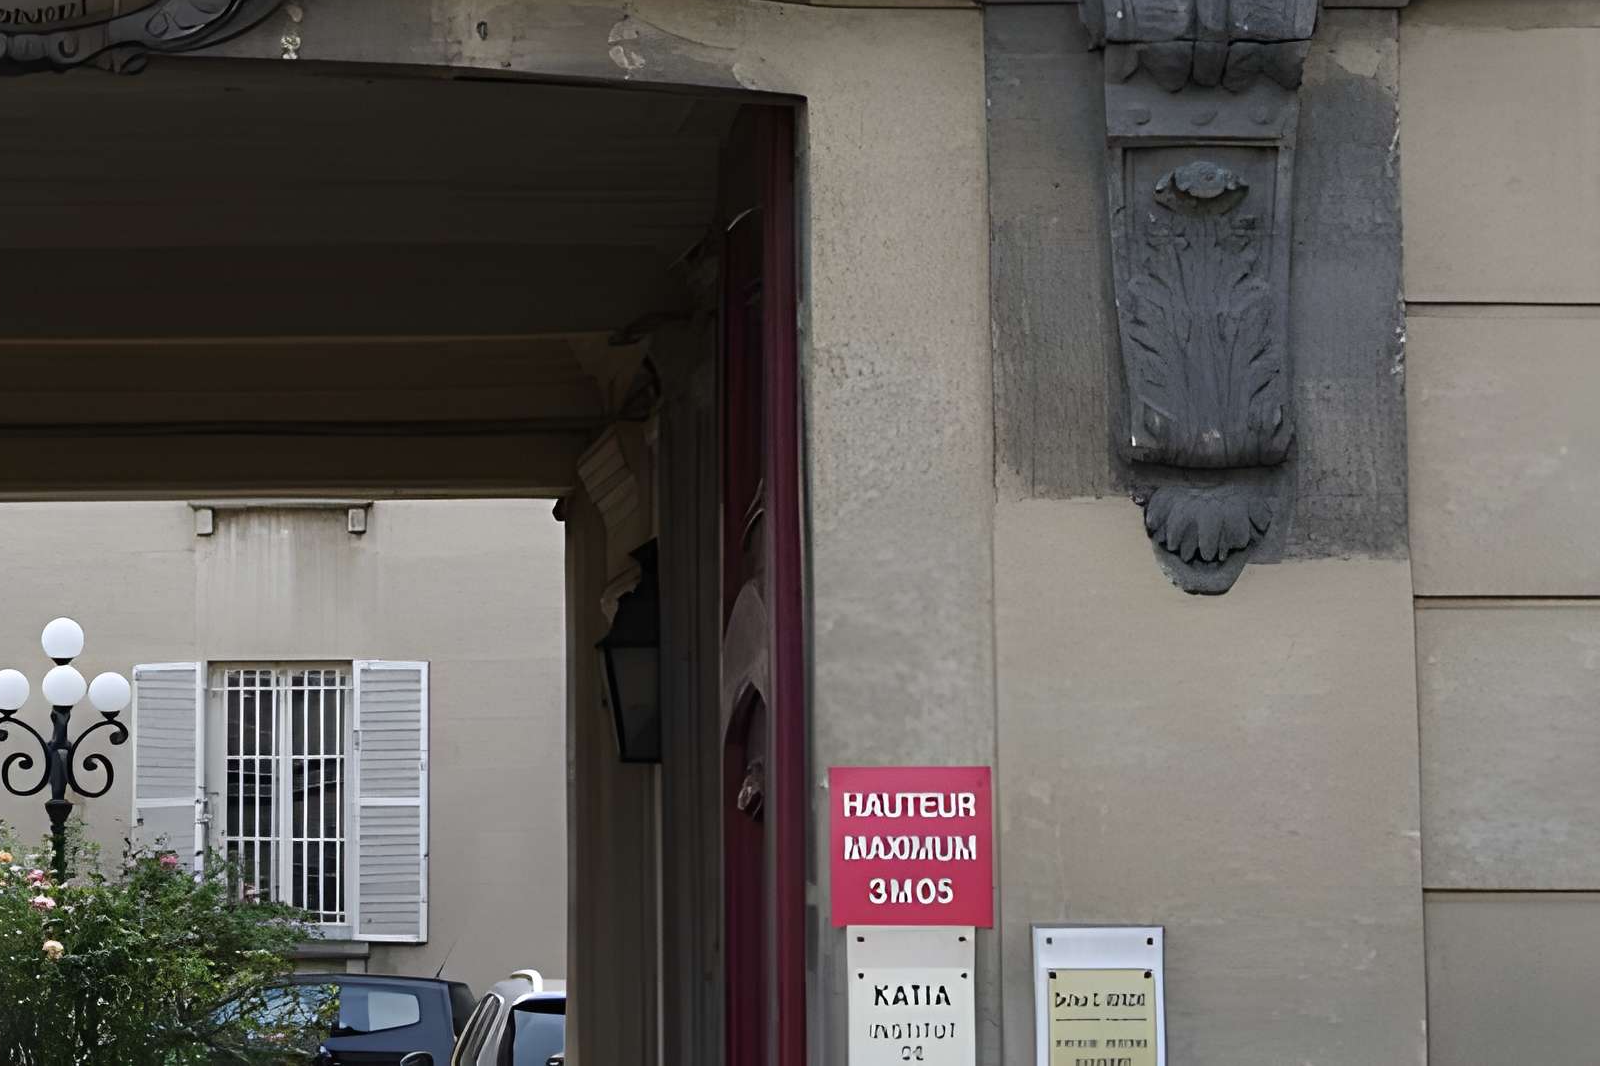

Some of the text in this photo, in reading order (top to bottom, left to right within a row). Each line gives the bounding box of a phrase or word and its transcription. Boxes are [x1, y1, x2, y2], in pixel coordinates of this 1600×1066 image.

[843, 791, 977, 819] HAUTEUR
[843, 834, 978, 862] MAXIMUM
[873, 983, 952, 1006] KATIA
